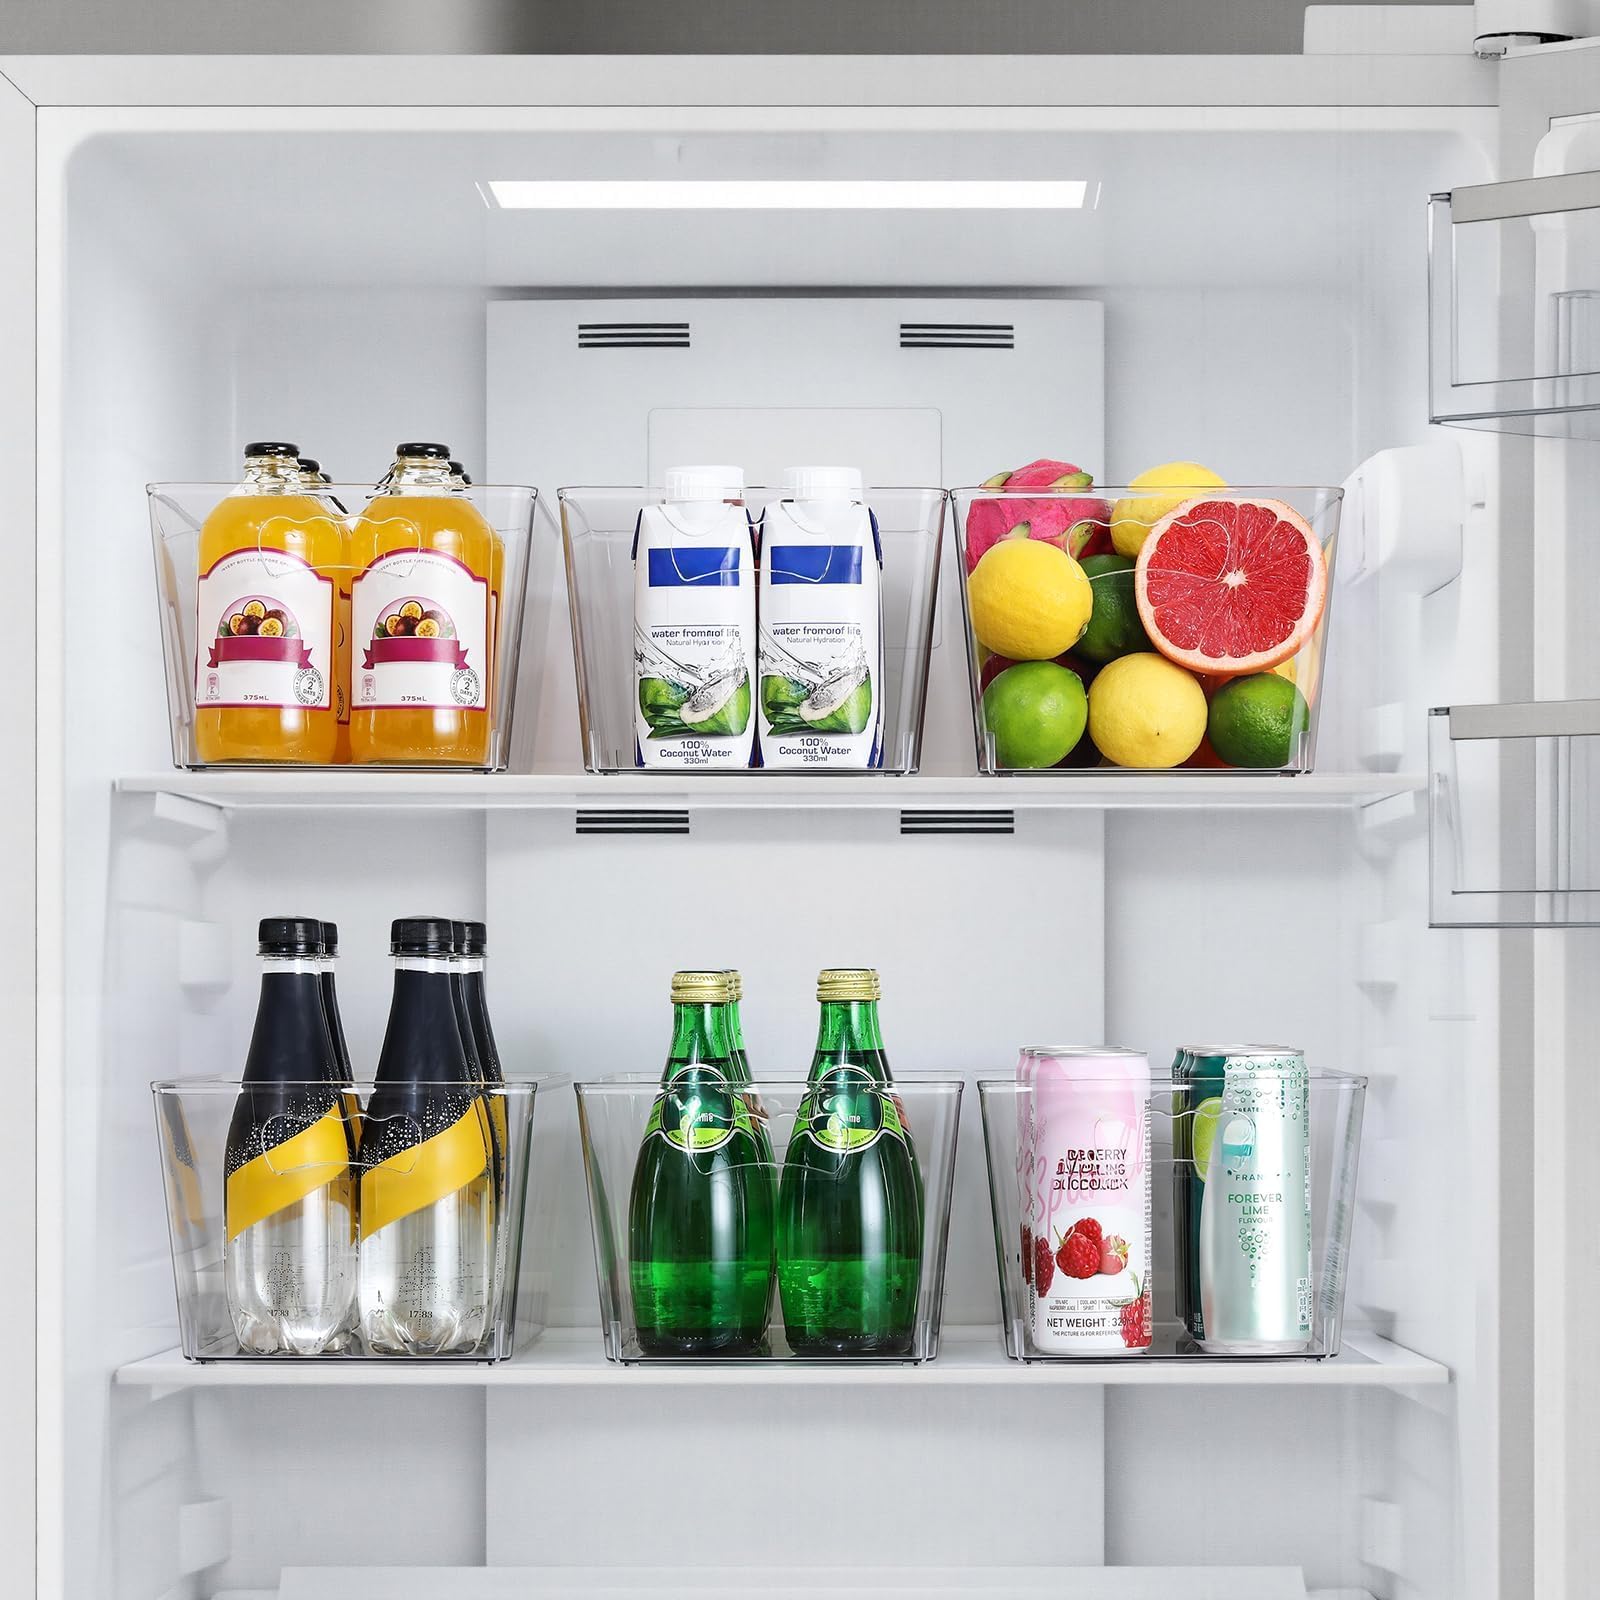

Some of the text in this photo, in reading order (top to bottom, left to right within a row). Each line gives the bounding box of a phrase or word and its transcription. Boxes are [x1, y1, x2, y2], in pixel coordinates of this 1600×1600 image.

[651, 630, 681, 638] water
[726, 628, 740, 638] life
[772, 628, 801, 636] water
[847, 626, 861, 635] life
[813, 637, 846, 645] Hydration
[307, 680, 314, 690] 2
[464, 681, 470, 691] 2
[680, 740, 710, 749] 100%
[800, 738, 829, 747] 100%
[659, 748, 733, 758] Coconut Water
[779, 746, 852, 755] Coconut Water
[1228, 1193, 1283, 1204] FOREVER
[1242, 1205, 1269, 1215] LIME
[1047, 1318, 1064, 1327] NET
[1065, 1318, 1106, 1328] WEIGHT
